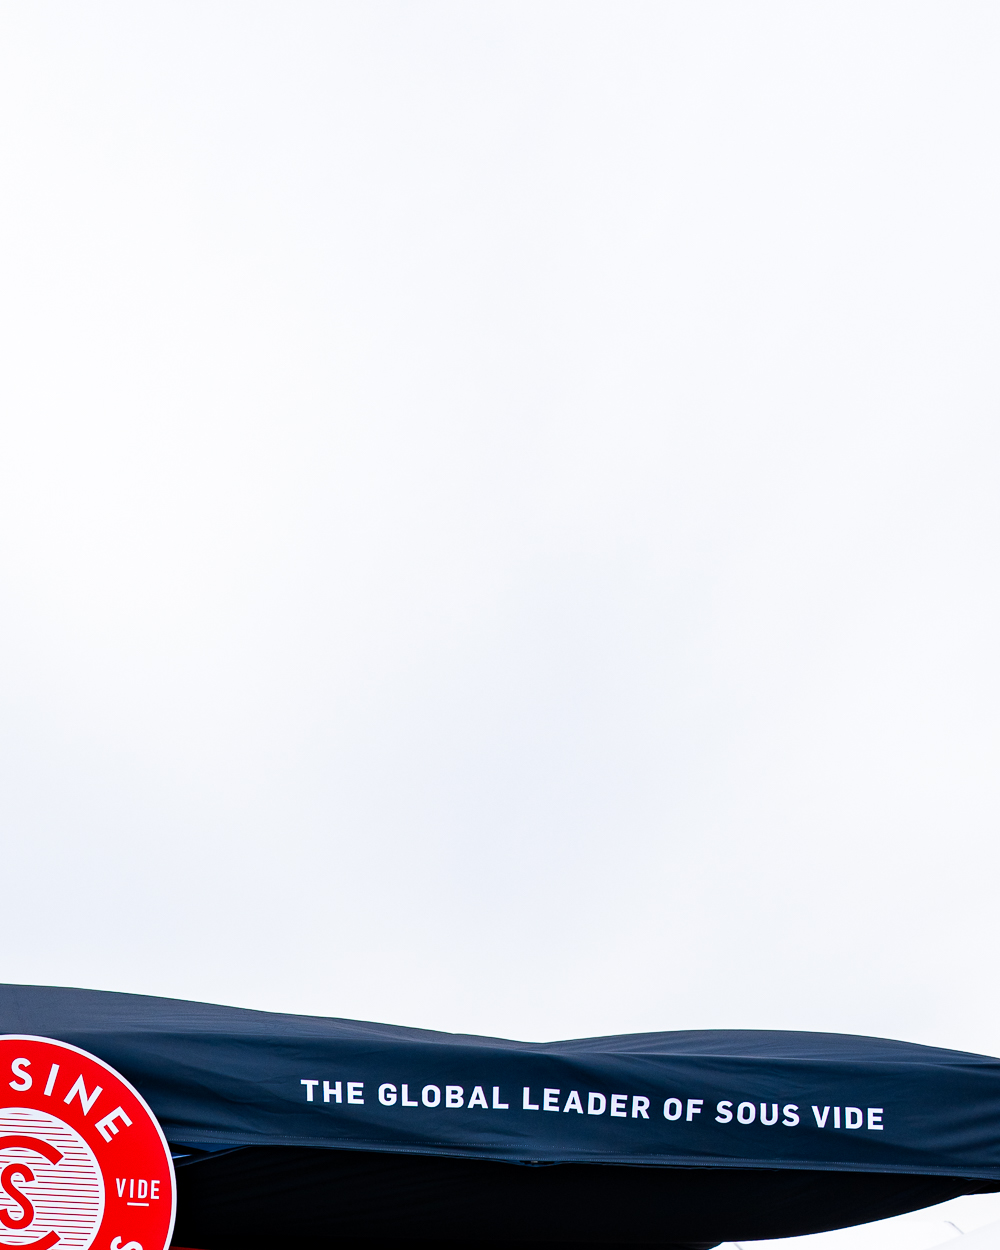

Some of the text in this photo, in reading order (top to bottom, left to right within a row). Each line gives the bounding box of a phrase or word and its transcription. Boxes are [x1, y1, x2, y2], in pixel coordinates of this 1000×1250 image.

[300, 1079, 885, 1131] THE GLOBAL LEADER OF SOUS VIDE
[115, 1177, 161, 1200] VIDE
